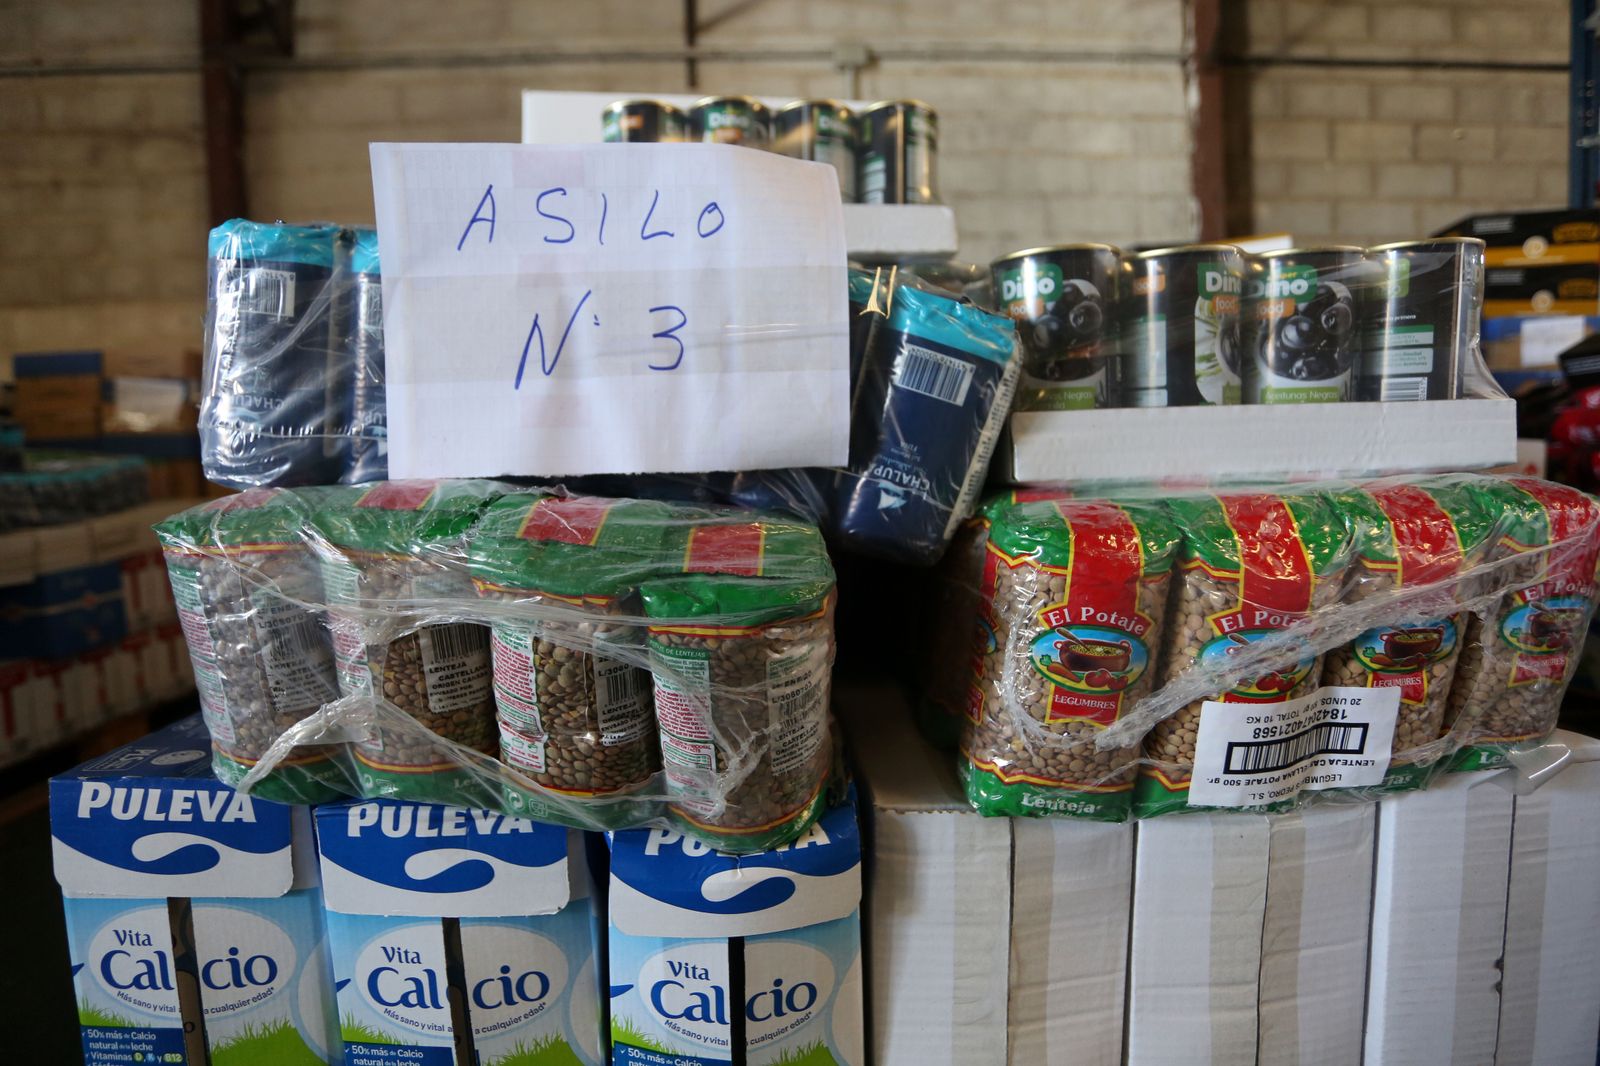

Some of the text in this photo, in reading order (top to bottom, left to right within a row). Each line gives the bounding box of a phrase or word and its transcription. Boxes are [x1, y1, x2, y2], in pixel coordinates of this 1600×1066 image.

[457, 184, 725, 251] ASILO
[1003, 273, 1056, 301] Dio
[1205, 270, 1242, 293] Din
[1250, 274, 1310, 299] Dino
[648, 305, 688, 371] 3
[1309, 386, 1338, 399] Negros
[1523, 584, 1547, 602] El
[1048, 606, 1146, 635] El Potaje
[1220, 613, 1246, 633] El
[429, 661, 467, 674] LENTEJA
[432, 680, 461, 690] ORIGEN
[1054, 694, 1117, 710] LEGUMBRES
[1350, 697, 1362, 706] 20
[1246, 715, 1262, 725] KG
[1263, 713, 1275, 723] 10
[1277, 708, 1300, 723] TOTAL
[1328, 758, 1376, 767] LENTEJA
[1223, 778, 1242, 787] 500
[1244, 774, 1281, 786] POTAJE
[77, 781, 257, 823] PULEVA
[347, 802, 534, 838] PULEVA
[112, 929, 153, 947] Vita
[380, 946, 422, 965] Vita
[666, 960, 711, 981] Vita
[117, 990, 133, 1004] Más
[132, 996, 152, 1009] sano
[152, 1003, 159, 1012] y
[158, 1003, 177, 1014] vital
[209, 999, 252, 1015] cualquier
[383, 1007, 400, 1021] Más
[400, 1015, 420, 1028] sano
[420, 1022, 427, 1031] y
[426, 1021, 446, 1033] vital
[481, 1016, 523, 1034] cualquier
[105, 1029, 124, 1040] más
[130, 1031, 157, 1041] Calcio
[664, 1019, 682, 1033] Más
[681, 1027, 702, 1041] sano
[702, 1036, 710, 1045] y
[709, 1035, 730, 1047] vital
[749, 1025, 790, 1046] cualquier
[89, 1041, 119, 1051] natural
[130, 1042, 153, 1051] leche
[351, 1044, 370, 1056] 50%
[370, 1047, 389, 1057] más
[397, 1048, 424, 1059] Calcio
[90, 1051, 133, 1061] Vitaminas
[156, 1055, 162, 1063] y
[627, 1047, 647, 1059] 50%
[646, 1053, 666, 1065] más
[674, 1057, 702, 1066] Calcio
